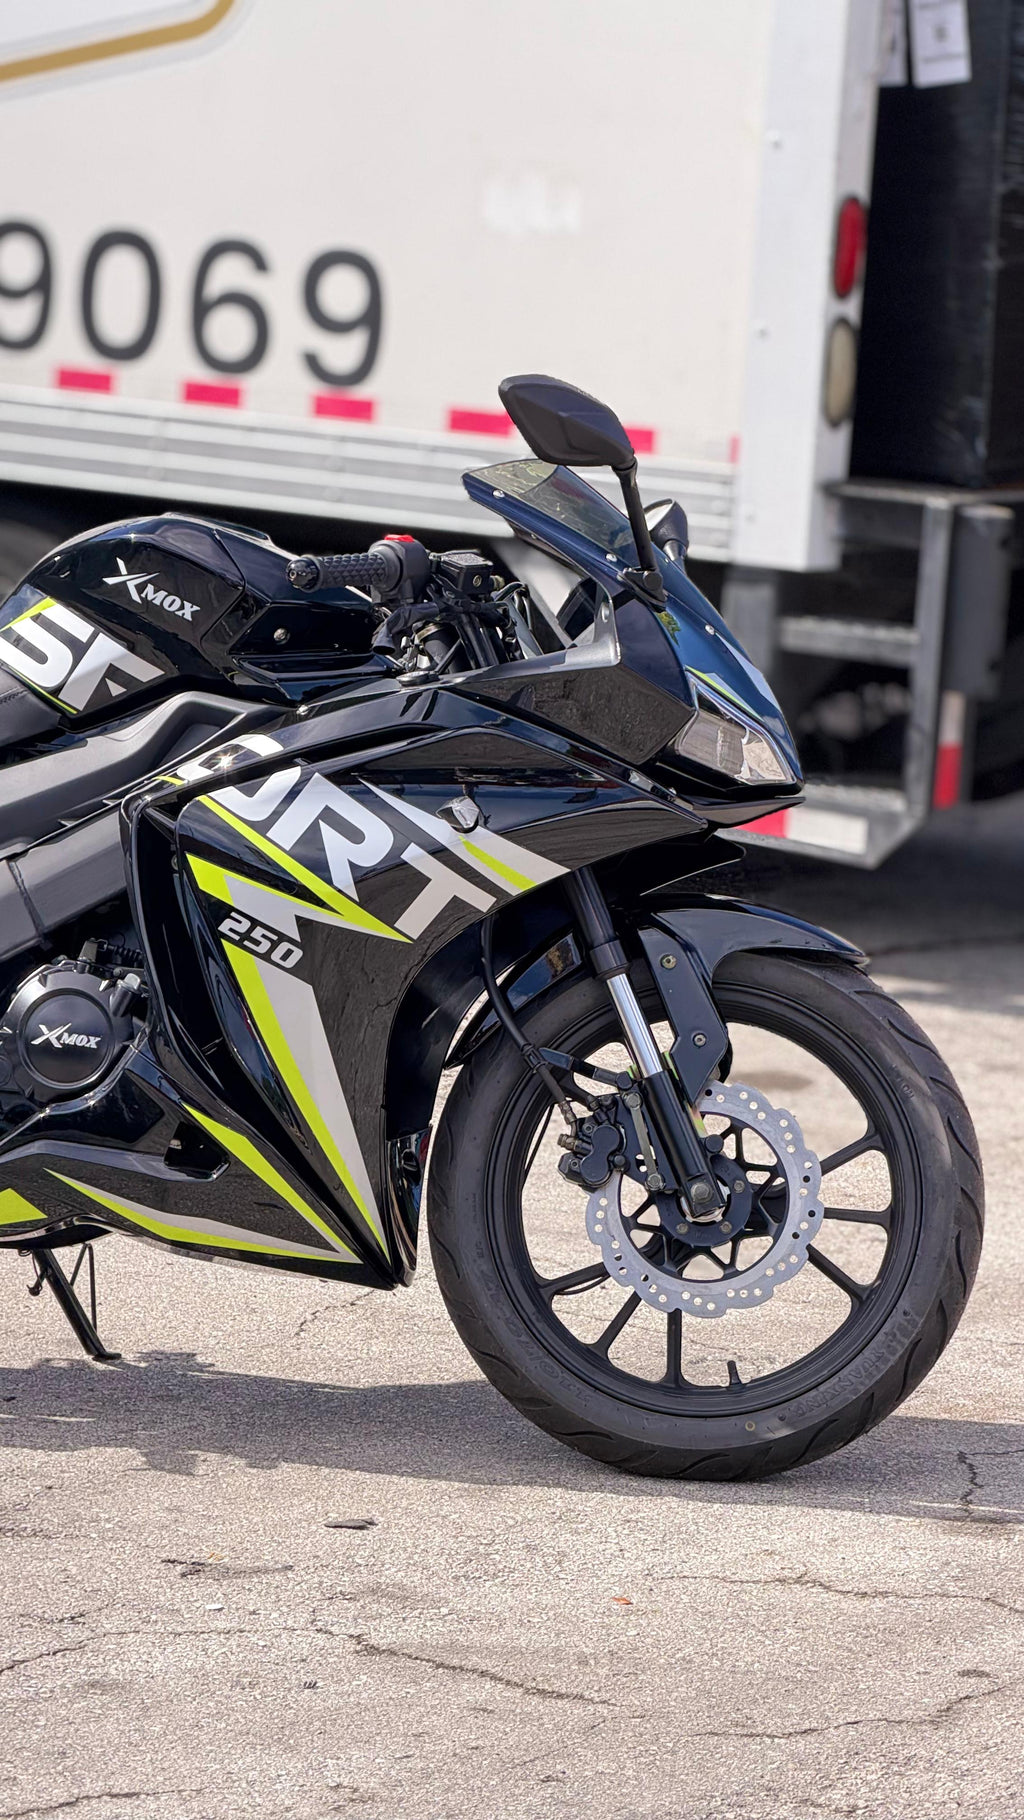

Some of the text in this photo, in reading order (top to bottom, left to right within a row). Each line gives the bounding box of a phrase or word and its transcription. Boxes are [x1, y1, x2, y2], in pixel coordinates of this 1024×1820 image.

[0, 222, 383, 386] 9069
[102, 557, 200, 625] XMOX
[218, 912, 303, 968] 250
[31, 1023, 101, 1048] XMOX
